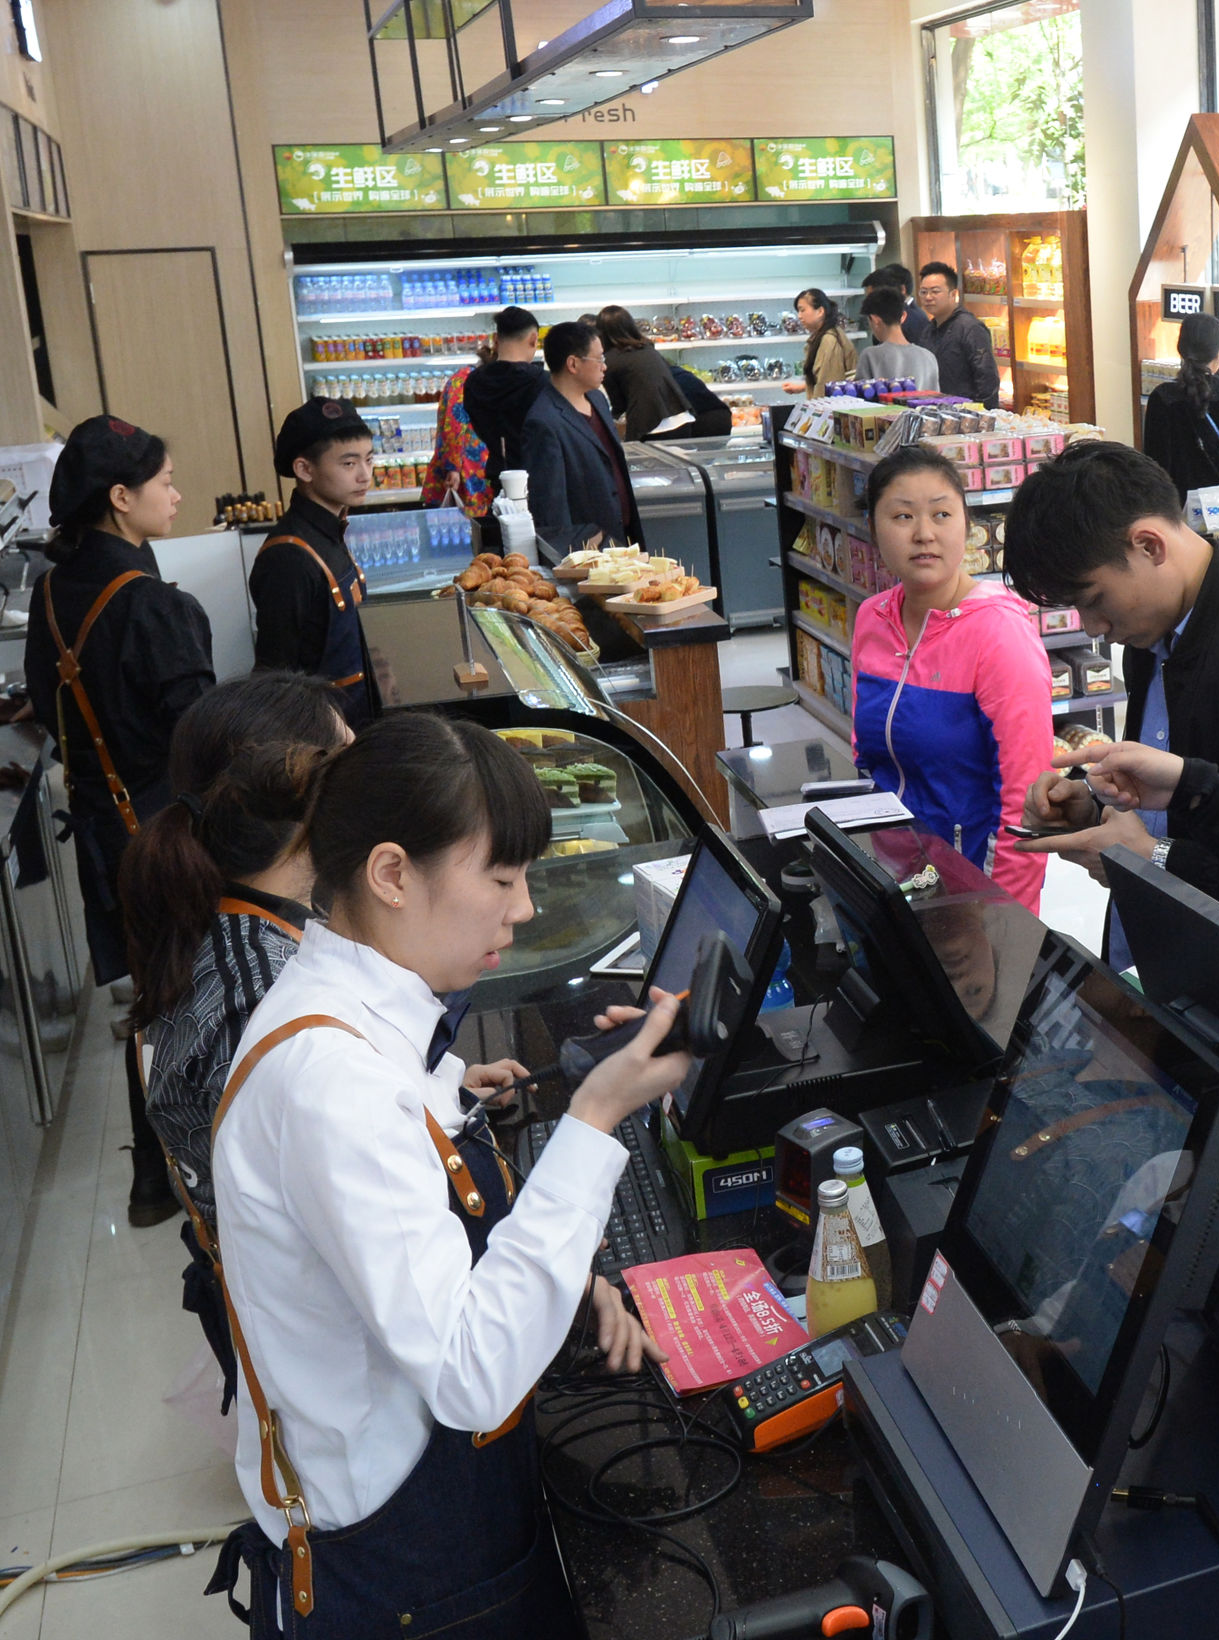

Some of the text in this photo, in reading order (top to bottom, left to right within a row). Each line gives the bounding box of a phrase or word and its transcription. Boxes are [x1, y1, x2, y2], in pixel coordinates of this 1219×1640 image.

[564, 103, 636, 122] resh
[331, 166, 398, 189] 生鲜区
[494, 162, 558, 184] 生鲜区
[651, 159, 711, 180] 生鲜区
[798, 157, 855, 177] 生鲜区
[1170, 293, 1201, 314] BEER
[720, 1170, 767, 1187] 450M
